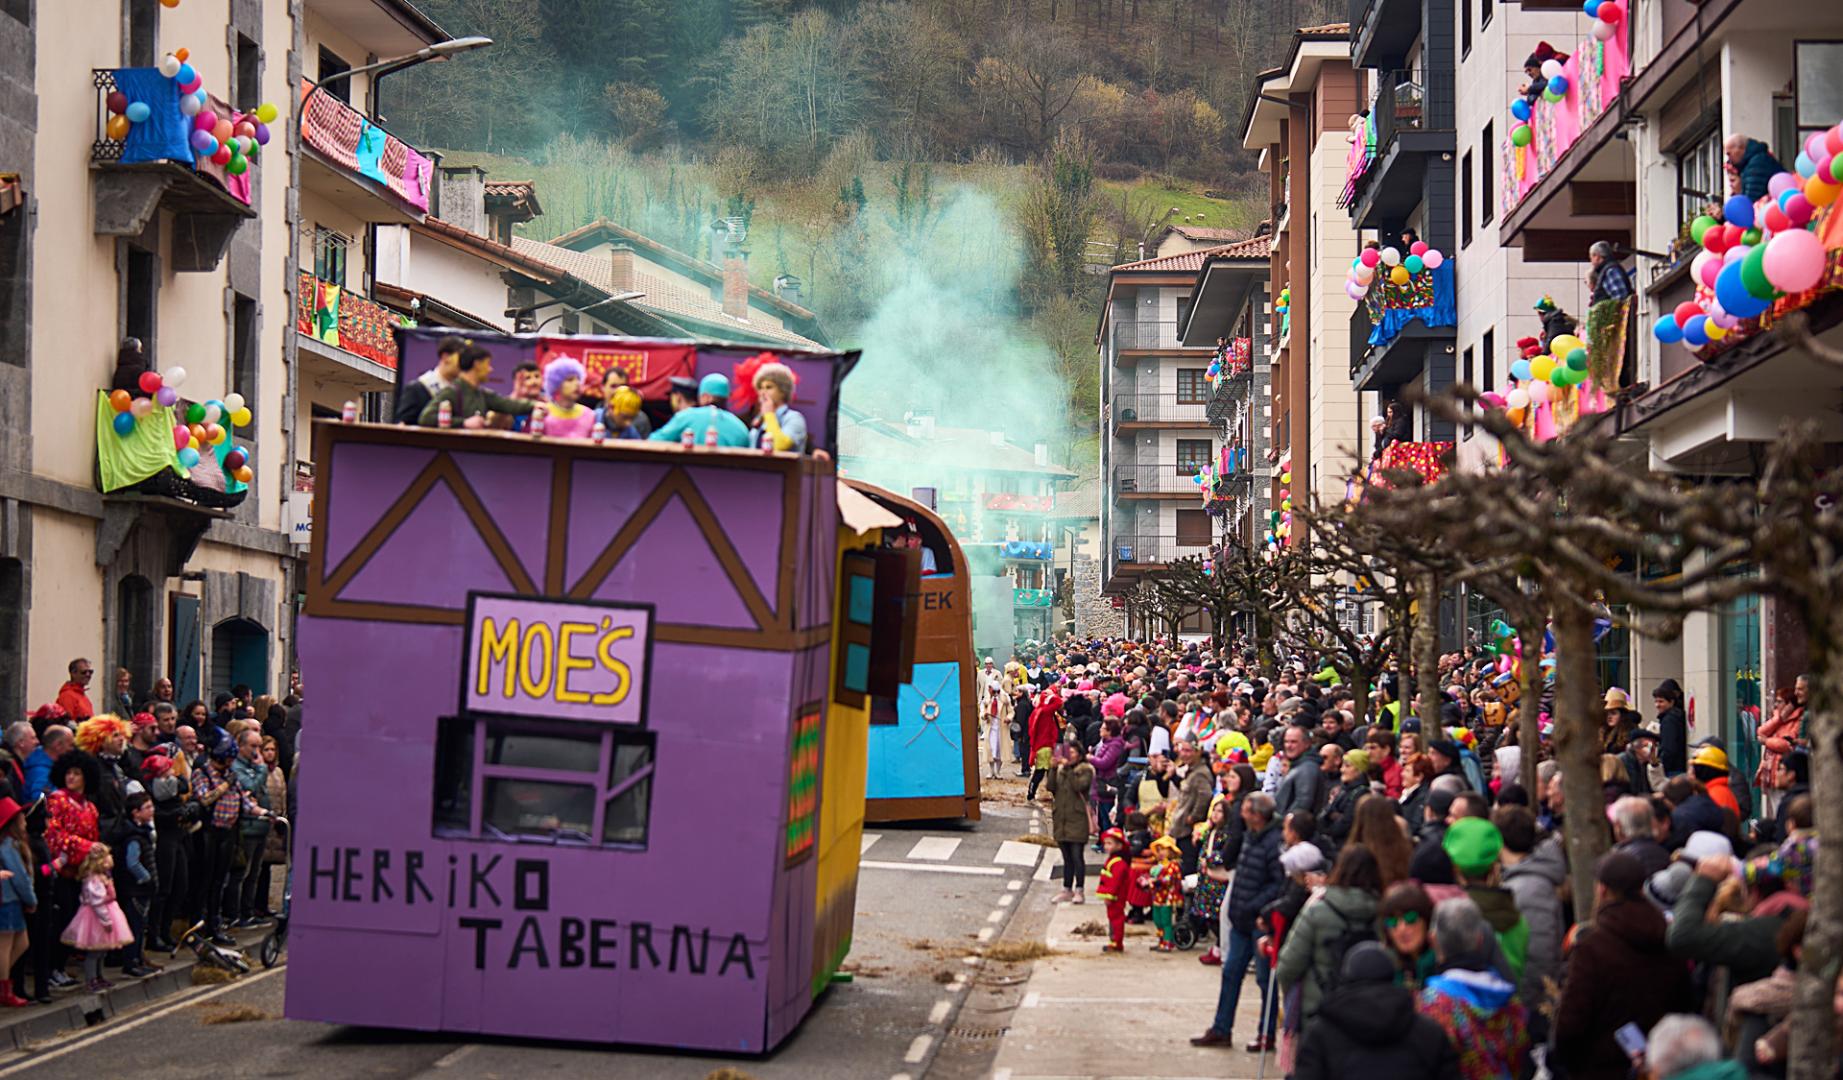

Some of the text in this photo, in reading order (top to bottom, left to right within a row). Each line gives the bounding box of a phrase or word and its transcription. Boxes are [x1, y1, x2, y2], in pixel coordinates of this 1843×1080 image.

[918, 591, 953, 610] EK
[475, 615, 634, 706] MOE'S
[459, 916, 755, 979] TABERNA
